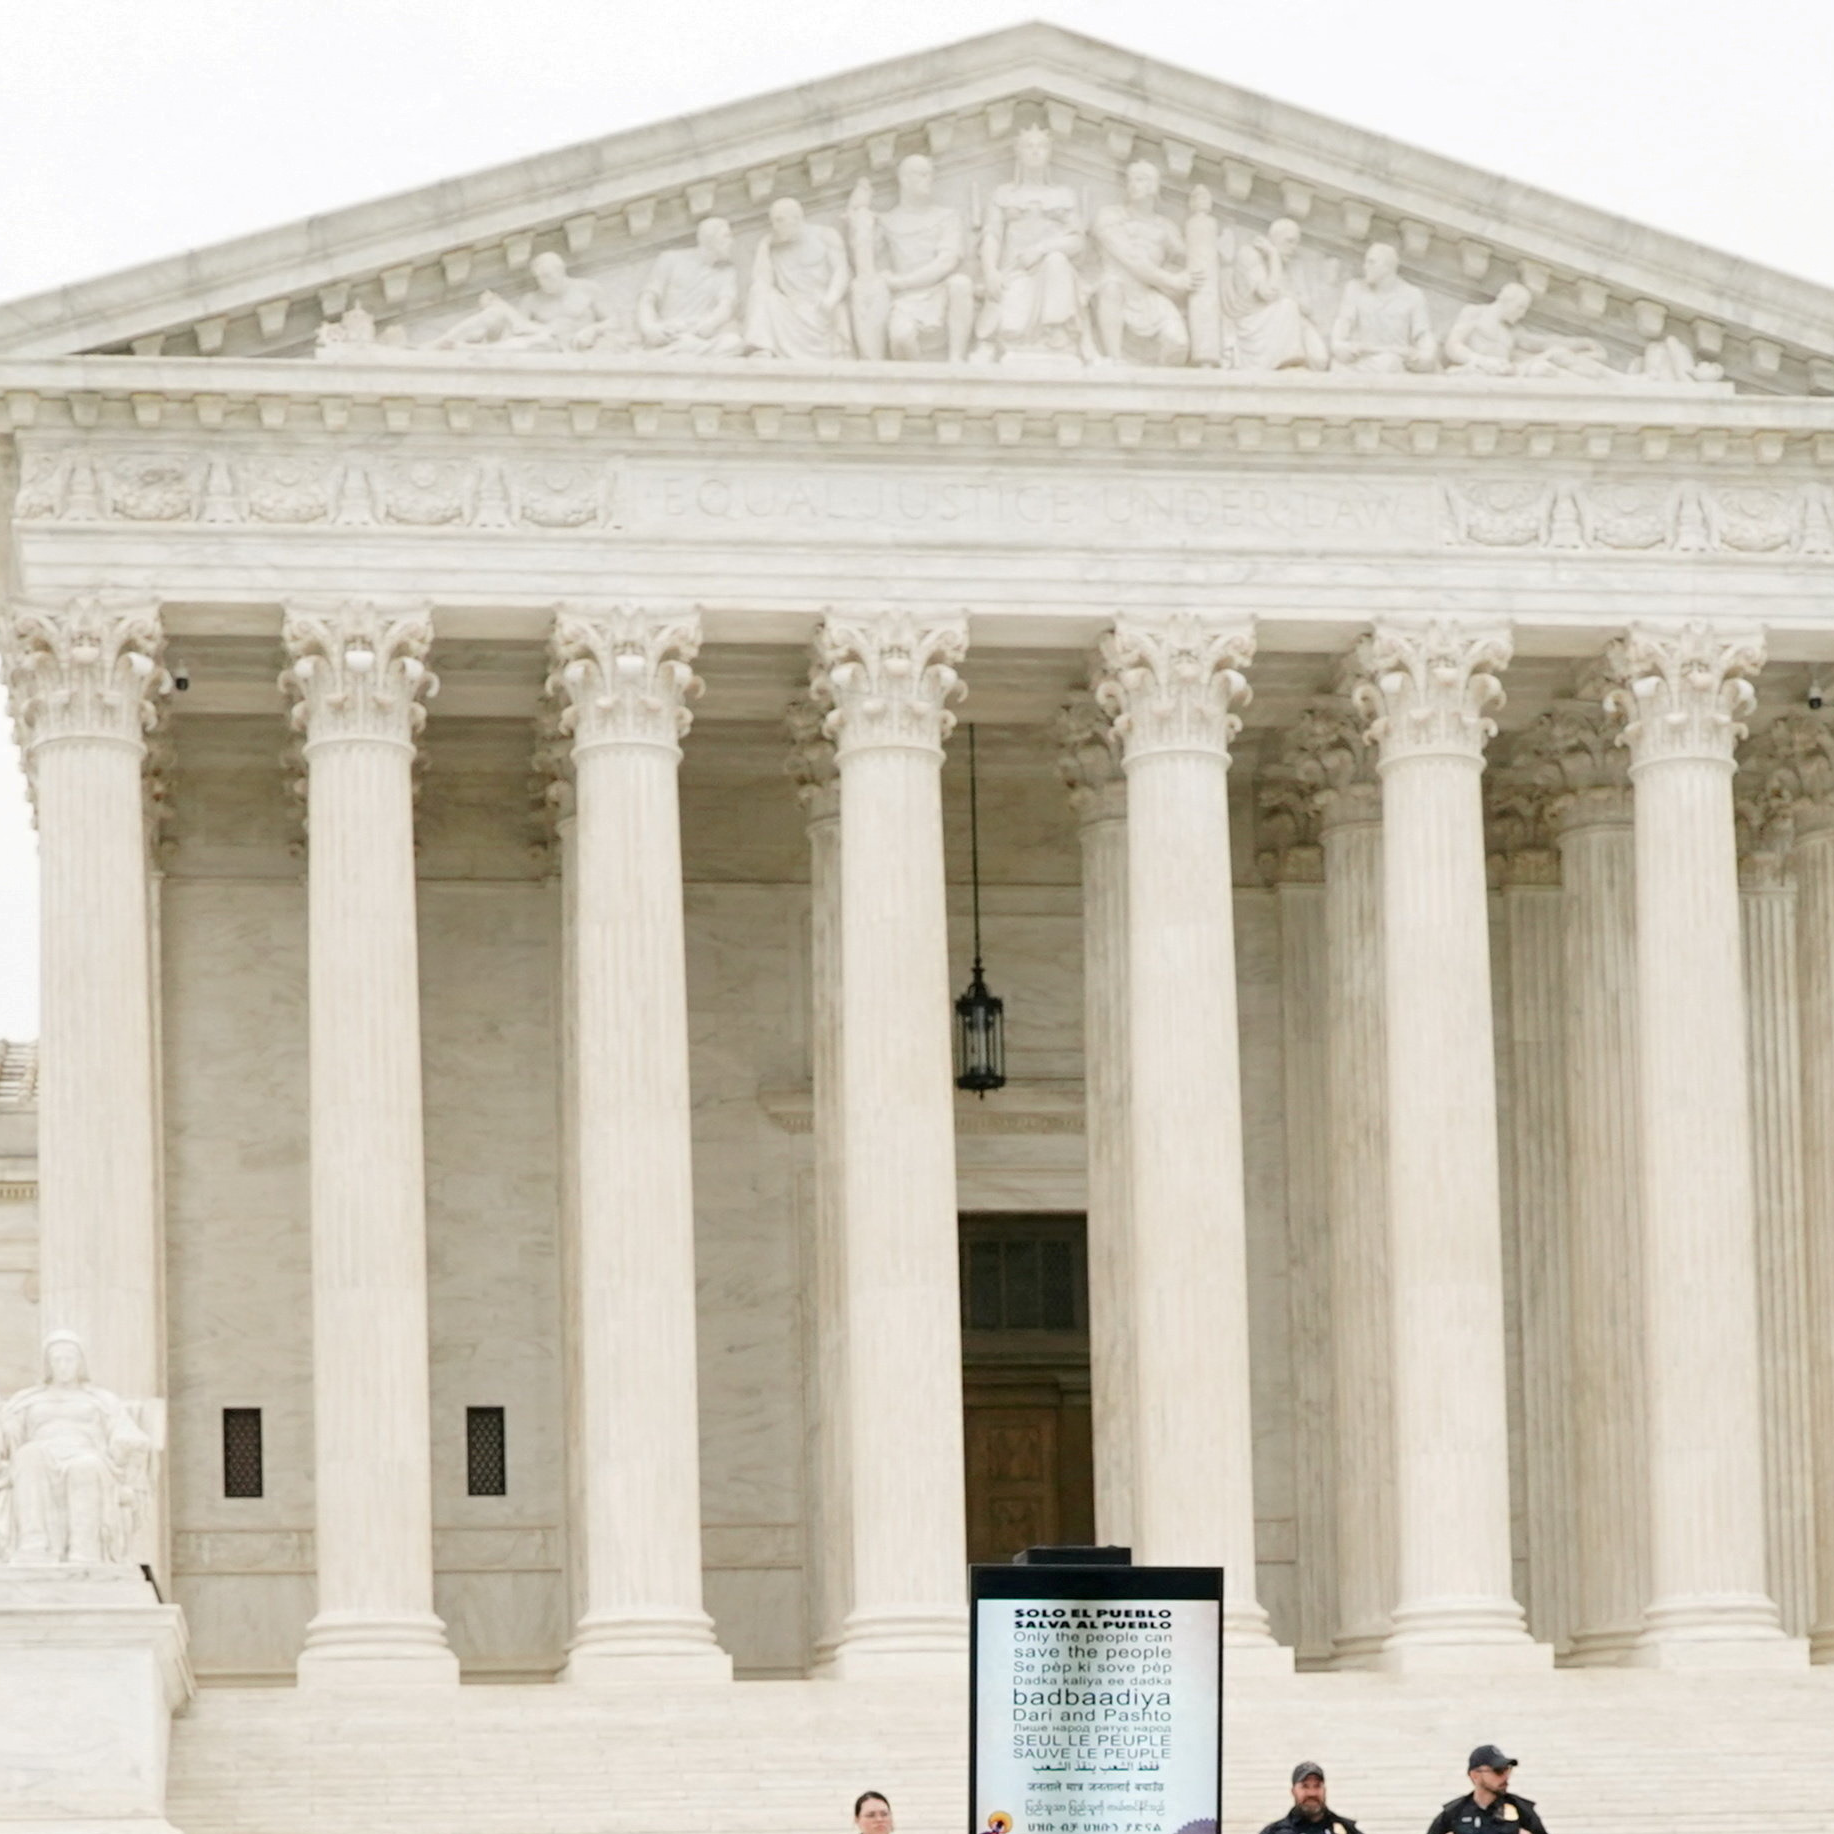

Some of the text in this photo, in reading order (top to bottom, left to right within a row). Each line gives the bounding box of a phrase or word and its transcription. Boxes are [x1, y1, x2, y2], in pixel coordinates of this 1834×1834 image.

[662, 478, 1405, 530] EQUAL JUSTICE UNDER LAW
[1014, 1609, 1172, 1618] SOLO EL PUEBLO
[1014, 1620, 1172, 1629] SALVA AL PUEBLO
[1013, 1631, 1173, 1645] Only the people can
[1013, 1646, 1172, 1661] save the people
[1013, 1661, 1035, 1673] Se
[1077, 1662, 1091, 1673] ki
[1097, 1664, 1135, 1673] sove
[1013, 1676, 1172, 1688] Dadka kaliya ee dadka
[1013, 1688, 1171, 1710] badbaadiya
[1013, 1708, 1172, 1722] Dari and Pashto
[1013, 1734, 1171, 1746] SEUL LE PEUPLE
[1013, 1748, 1171, 1759] SAUVE LE PEUPLE
